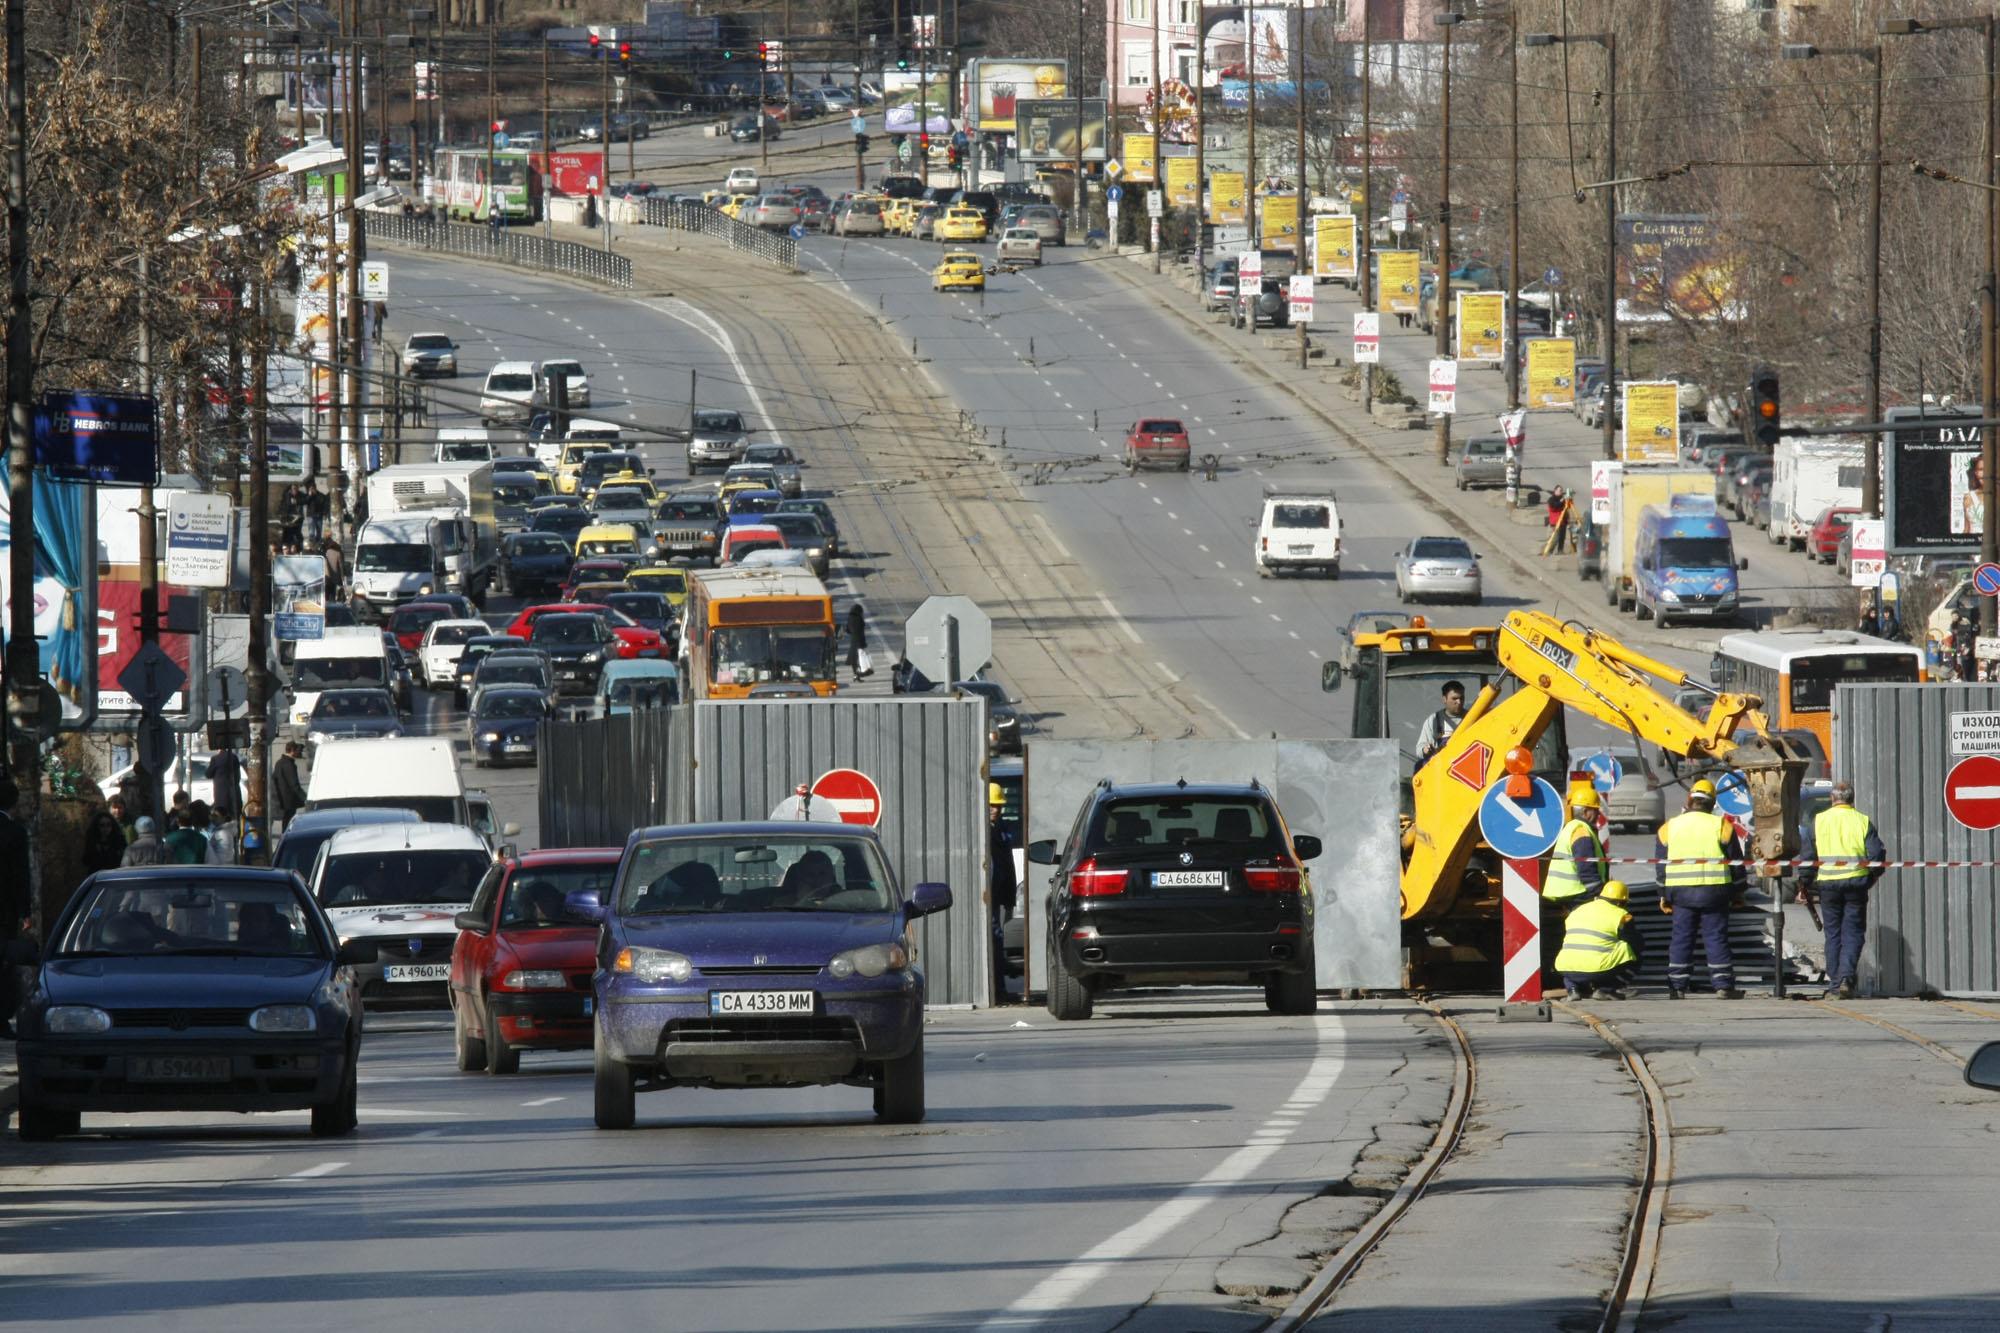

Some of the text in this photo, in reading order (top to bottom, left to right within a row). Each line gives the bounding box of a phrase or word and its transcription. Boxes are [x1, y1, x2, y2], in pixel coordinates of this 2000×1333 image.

[74, 419, 150, 433] HEBROS BANK
[1962, 716, 2000, 728] ИЗХОД
[1953, 730, 2000, 740] СТРОИТЕЛ
[1159, 873, 1174, 885] CA
[1205, 872, 1221, 884] KH
[391, 966, 449, 978] CA 4960 HK
[722, 993, 811, 1011] CA 4338 MM
